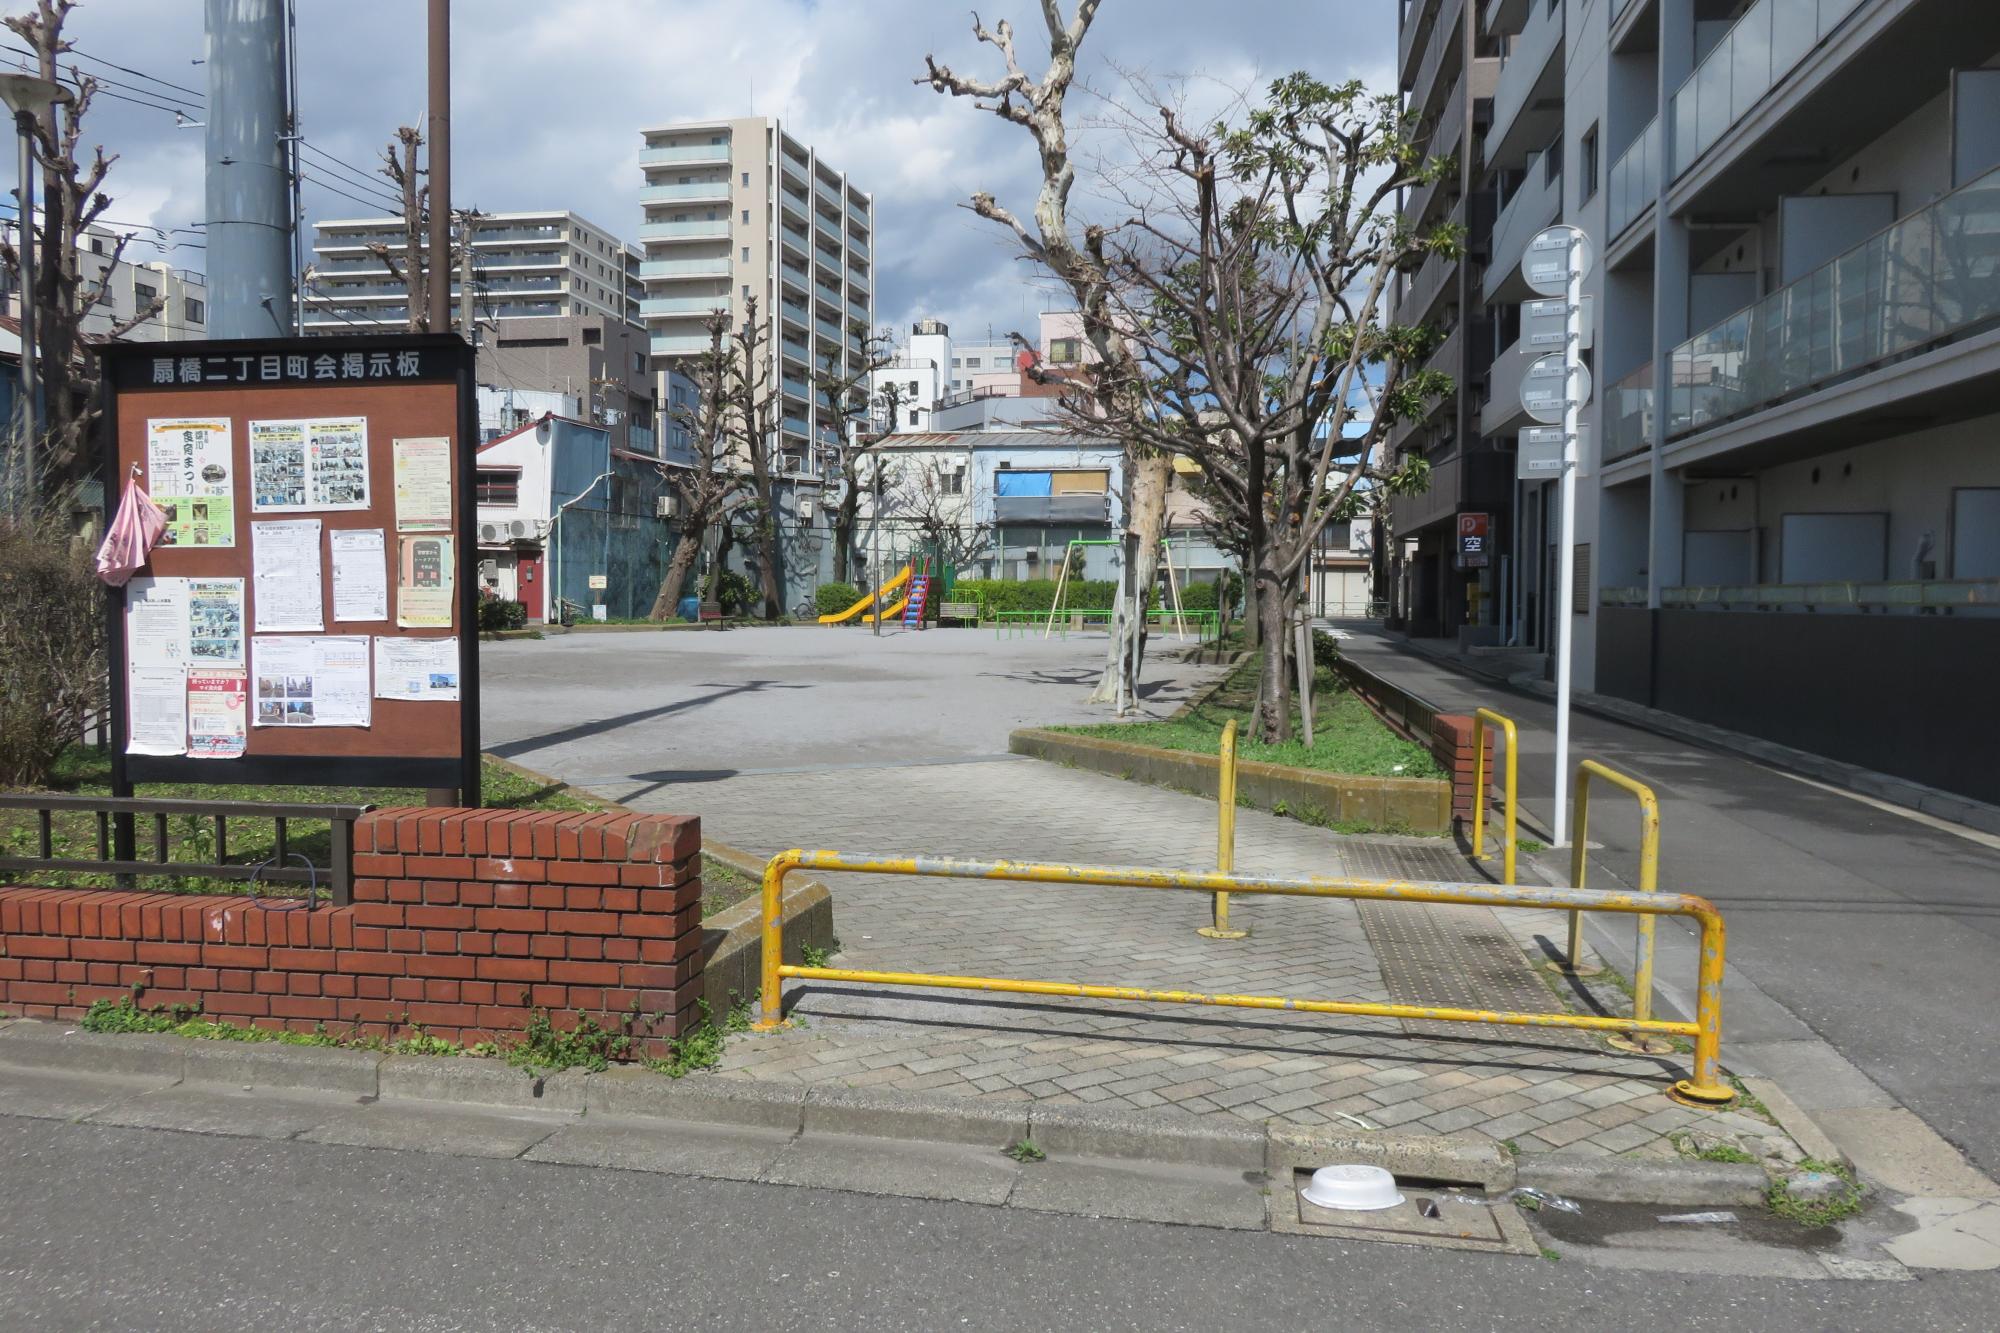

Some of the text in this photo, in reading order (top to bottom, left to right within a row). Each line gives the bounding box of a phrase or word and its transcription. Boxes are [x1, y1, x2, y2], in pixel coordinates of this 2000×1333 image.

[152, 351, 421, 384] 扇橋二丁目町会掲示板
[1464, 535, 1482, 552] 空
